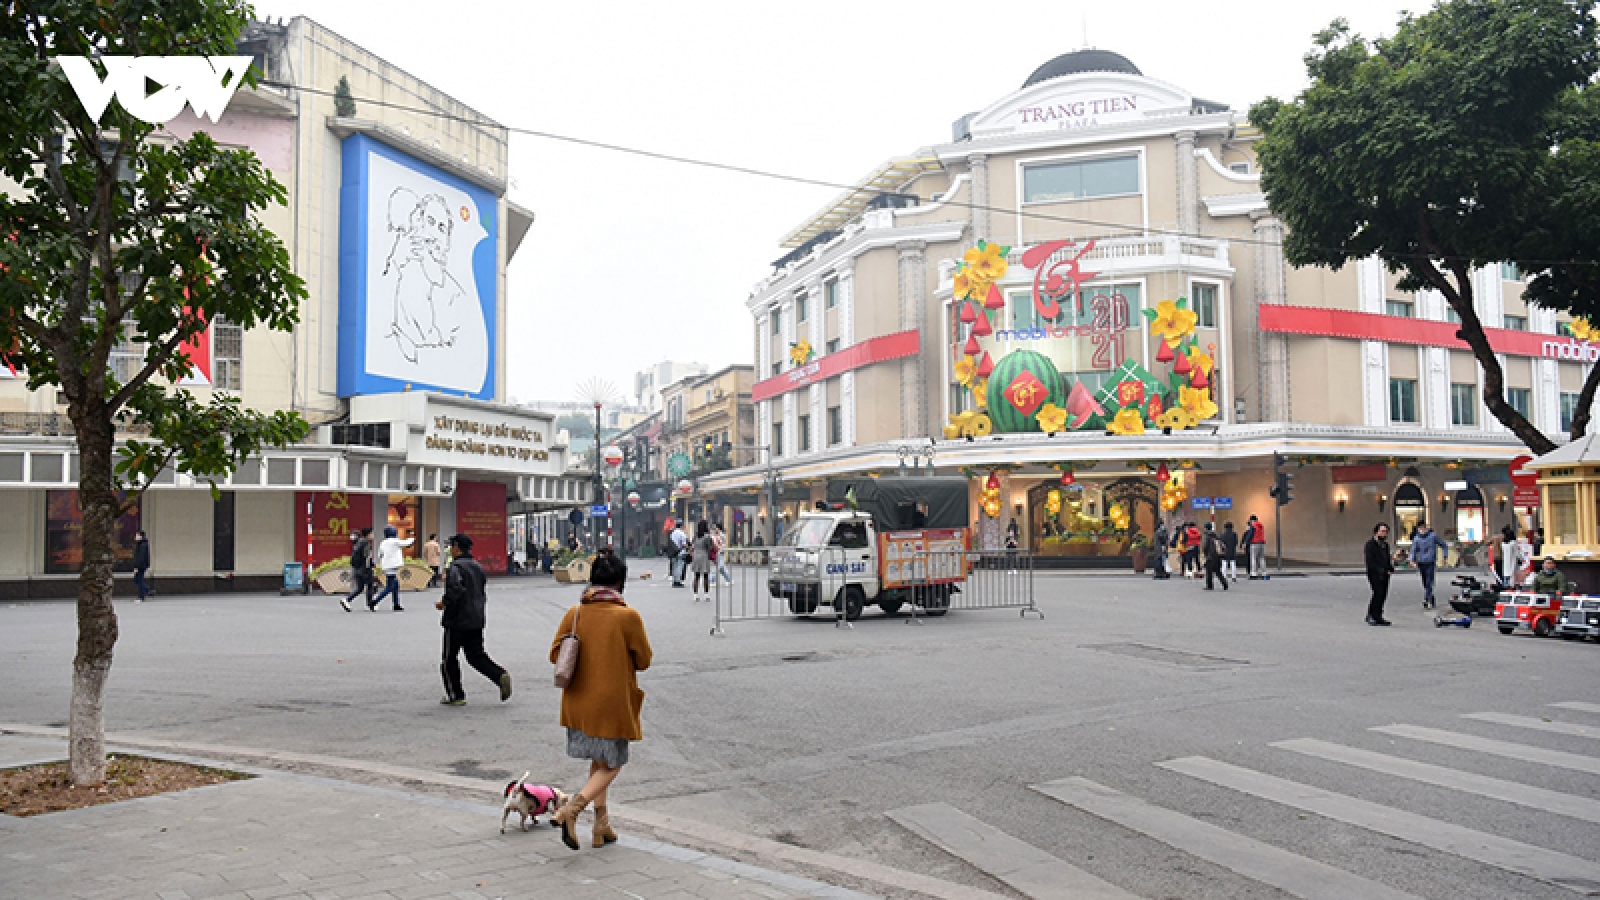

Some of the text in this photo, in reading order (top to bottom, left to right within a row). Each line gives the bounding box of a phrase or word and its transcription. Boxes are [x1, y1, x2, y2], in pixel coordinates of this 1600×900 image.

[1018, 96, 1136, 123] TRANG TIEN
[1090, 294, 1129, 333] 20
[1091, 333, 1125, 368] 21
[329, 518, 348, 535] 91
